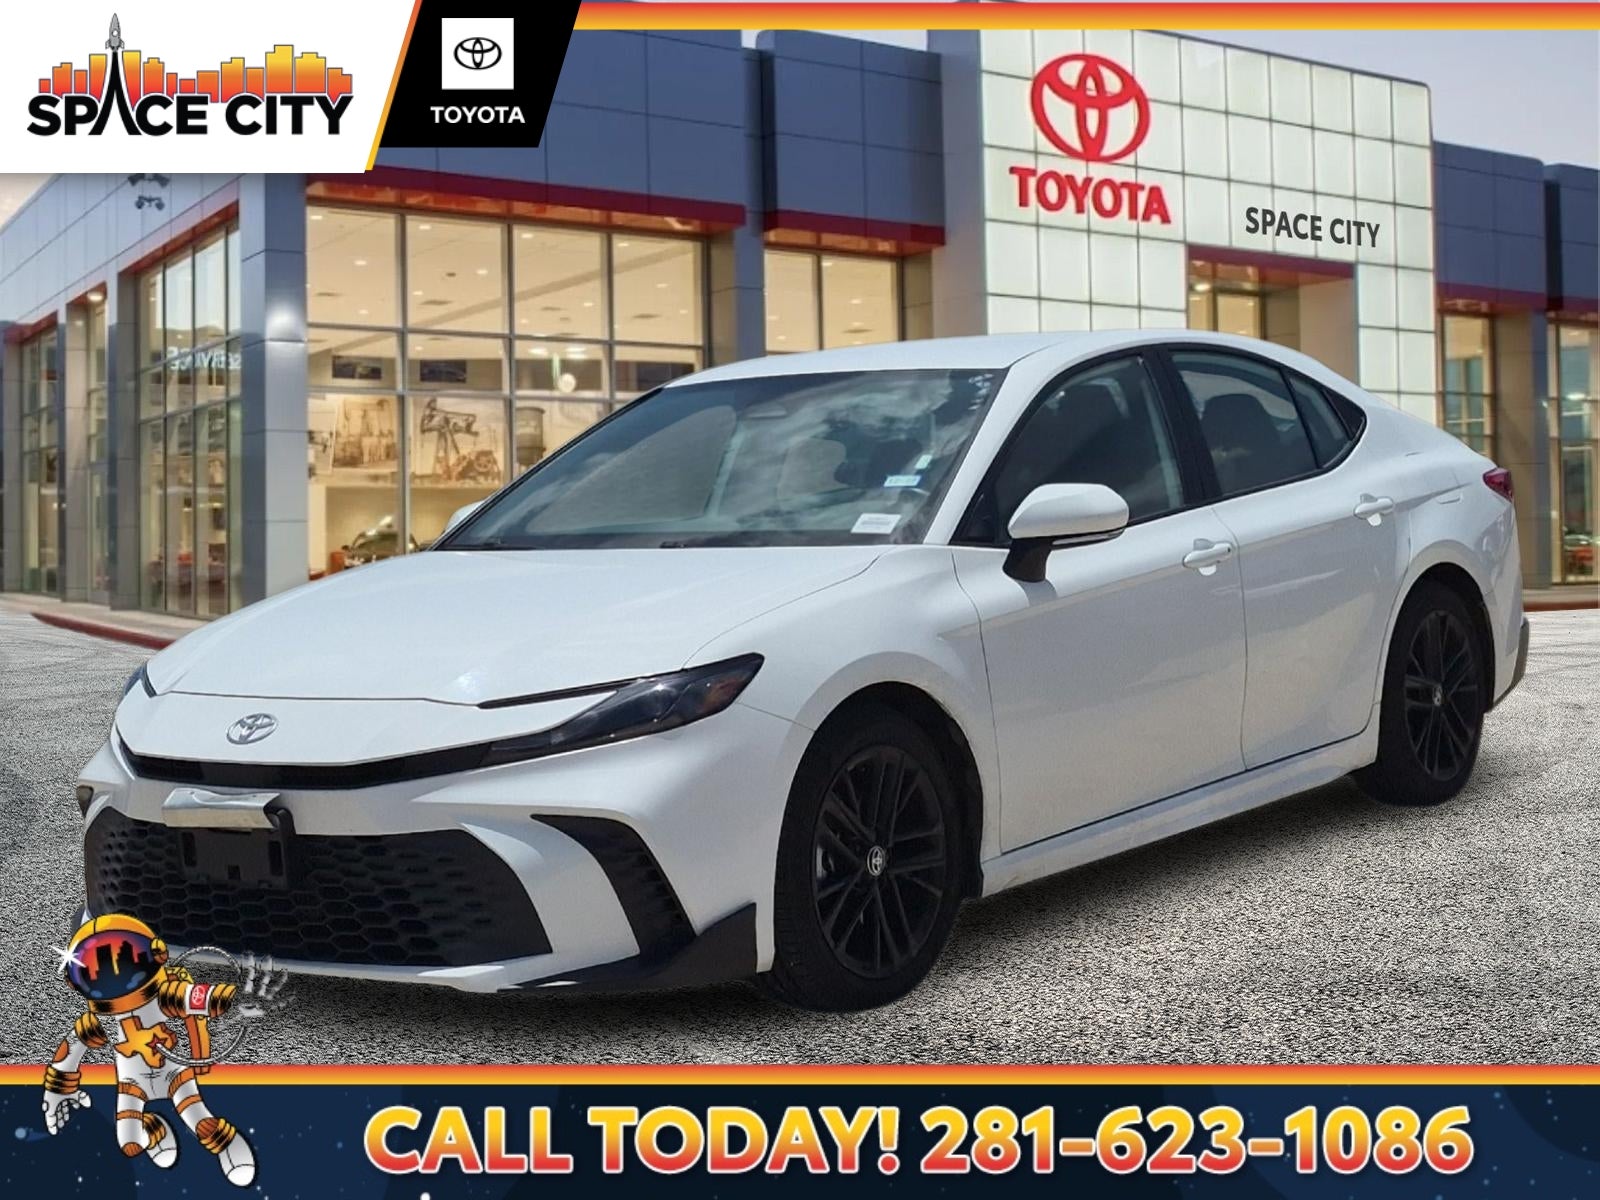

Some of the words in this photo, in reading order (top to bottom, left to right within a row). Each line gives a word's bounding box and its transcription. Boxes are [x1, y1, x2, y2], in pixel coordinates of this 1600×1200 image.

[1009, 166, 1171, 224] TOYOTA
[1245, 206, 1323, 242] SPACE
[1329, 218, 1381, 248] CITY
